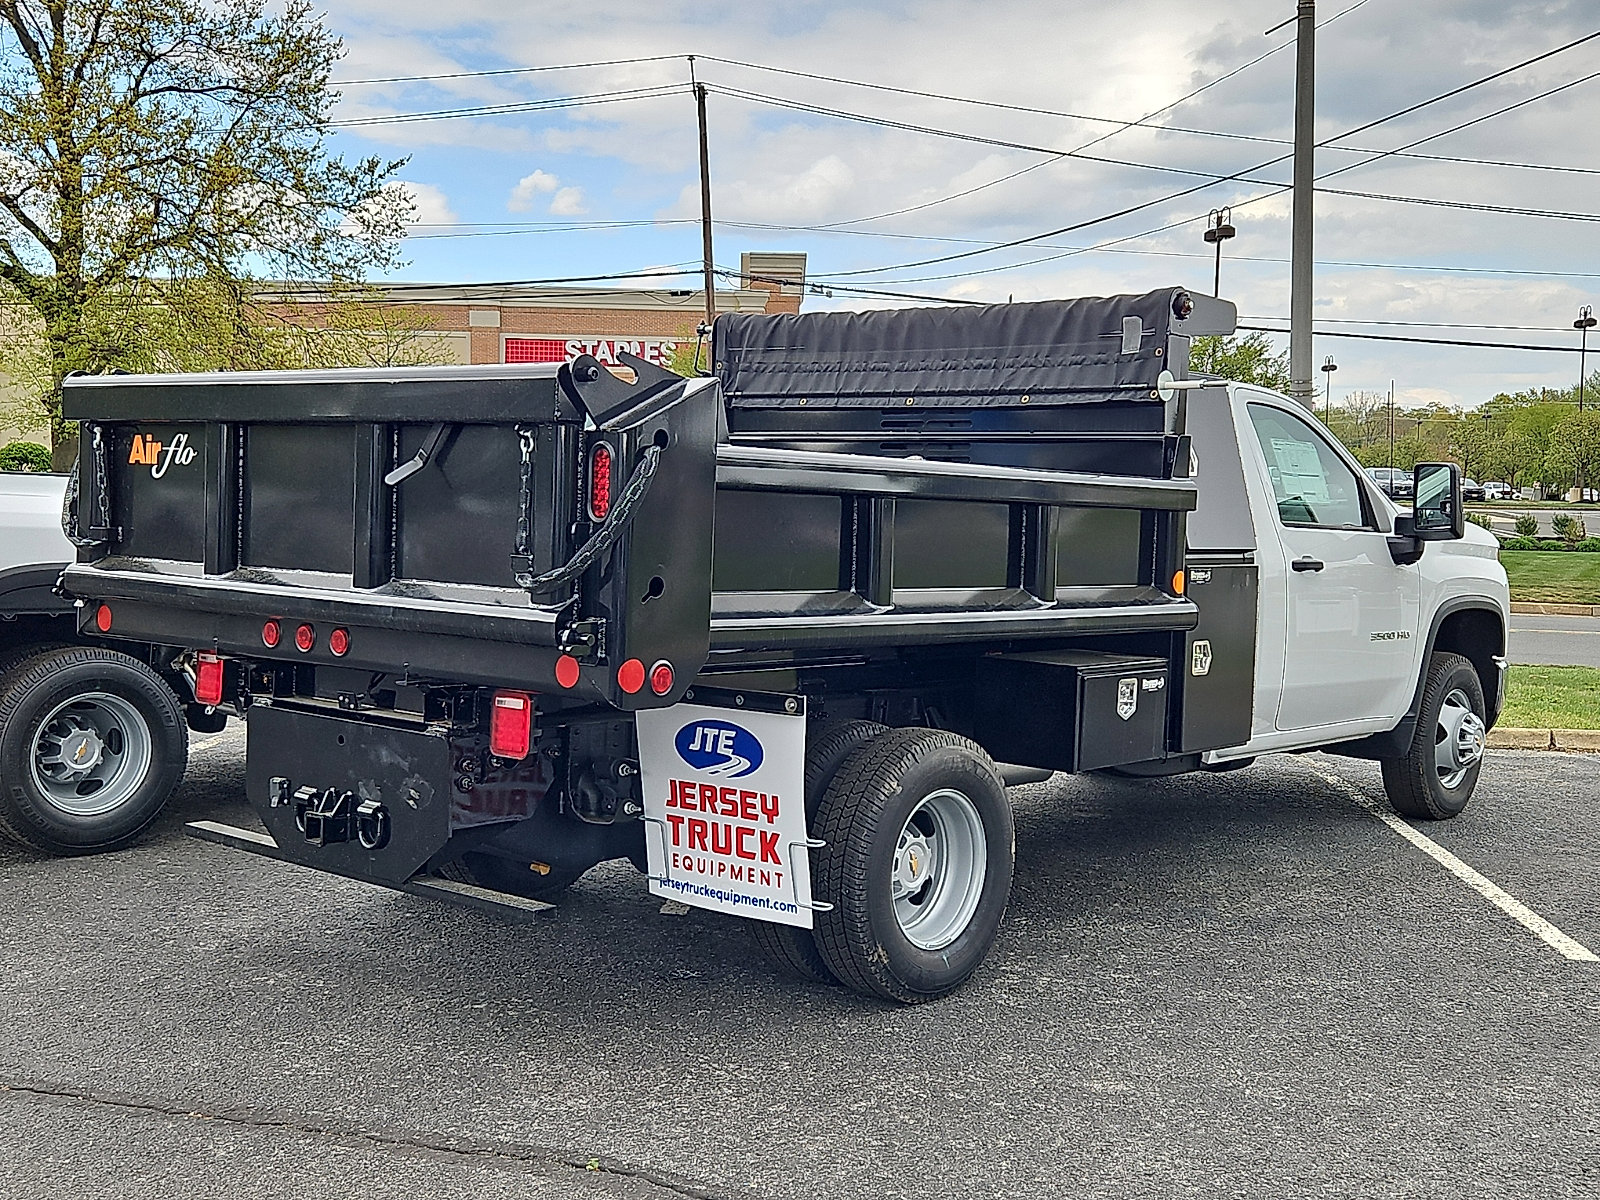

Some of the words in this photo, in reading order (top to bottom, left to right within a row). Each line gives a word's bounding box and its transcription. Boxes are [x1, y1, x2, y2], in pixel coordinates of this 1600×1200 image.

[1370, 631, 1395, 641] 3500
[1396, 631, 1411, 640] HD
[689, 727, 737, 755] JTE
[665, 779, 780, 825] JERSEY
[666, 813, 783, 866] TRUCK
[672, 852, 784, 889] EQUIPMENT
[659, 873, 798, 914] jerseytruckequipment.com
